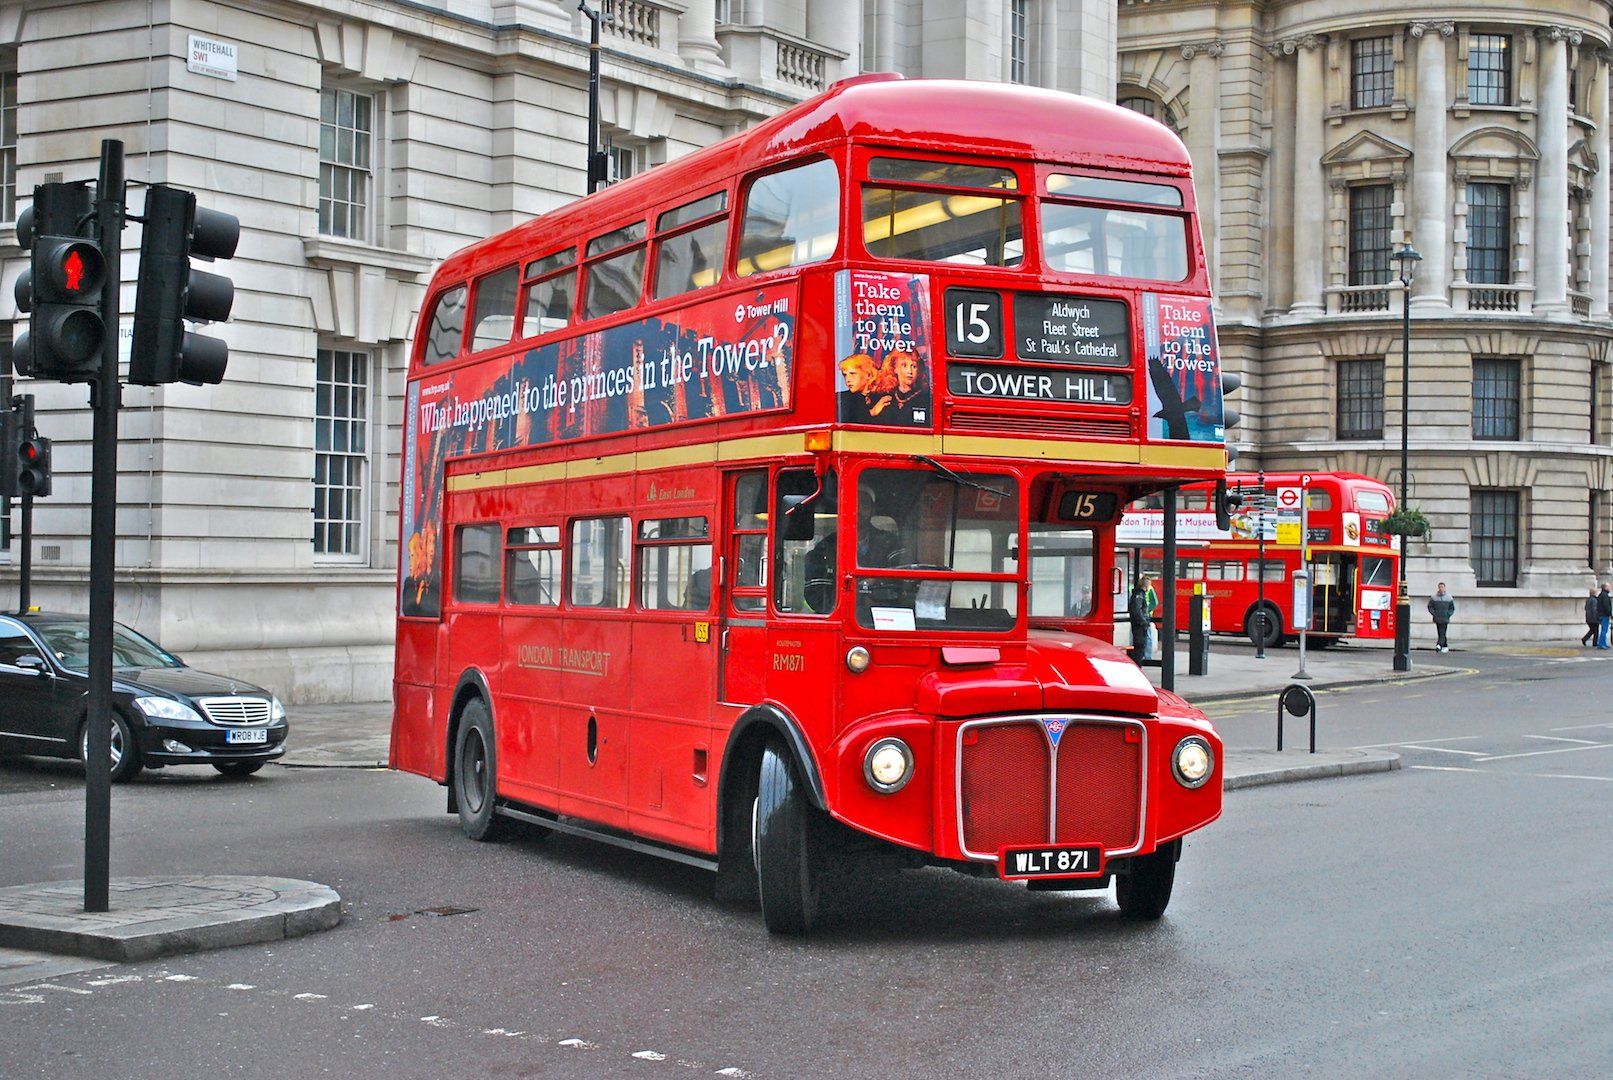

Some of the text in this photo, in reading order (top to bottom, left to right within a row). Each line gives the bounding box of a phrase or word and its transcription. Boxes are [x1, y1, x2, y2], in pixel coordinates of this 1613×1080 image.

[193, 40, 233, 57] WHITEHALL
[193, 51, 208, 62] SW1
[854, 281, 900, 300] Take
[747, 298, 788, 318] Tower Hill
[855, 299, 905, 317] them
[1052, 303, 1090, 321] Aldwych
[1160, 304, 1201, 322] Take
[855, 317, 911, 335] to the
[956, 302, 991, 344] 15
[1043, 321, 1099, 338] Fleet Street
[1162, 321, 1205, 339] them
[856, 334, 915, 353] Tower
[1026, 338, 1118, 357] St Paul's Cathedral
[1163, 339, 1211, 356] to the
[1163, 353, 1215, 372] Tower
[421, 322, 789, 434] What happened to the princes in the Tower?
[961, 372, 1117, 402] TOWER HILL
[1302, 475, 1311, 487] P
[1073, 494, 1098, 518] 15
[1120, 518, 1139, 526] ndon
[1143, 517, 1182, 526] Transrt
[518, 645, 611, 677] LONDON TRANSPORT
[773, 653, 804, 671] RM871
[253, 731, 266, 740] YJE
[1016, 851, 1088, 872] WLT 871
